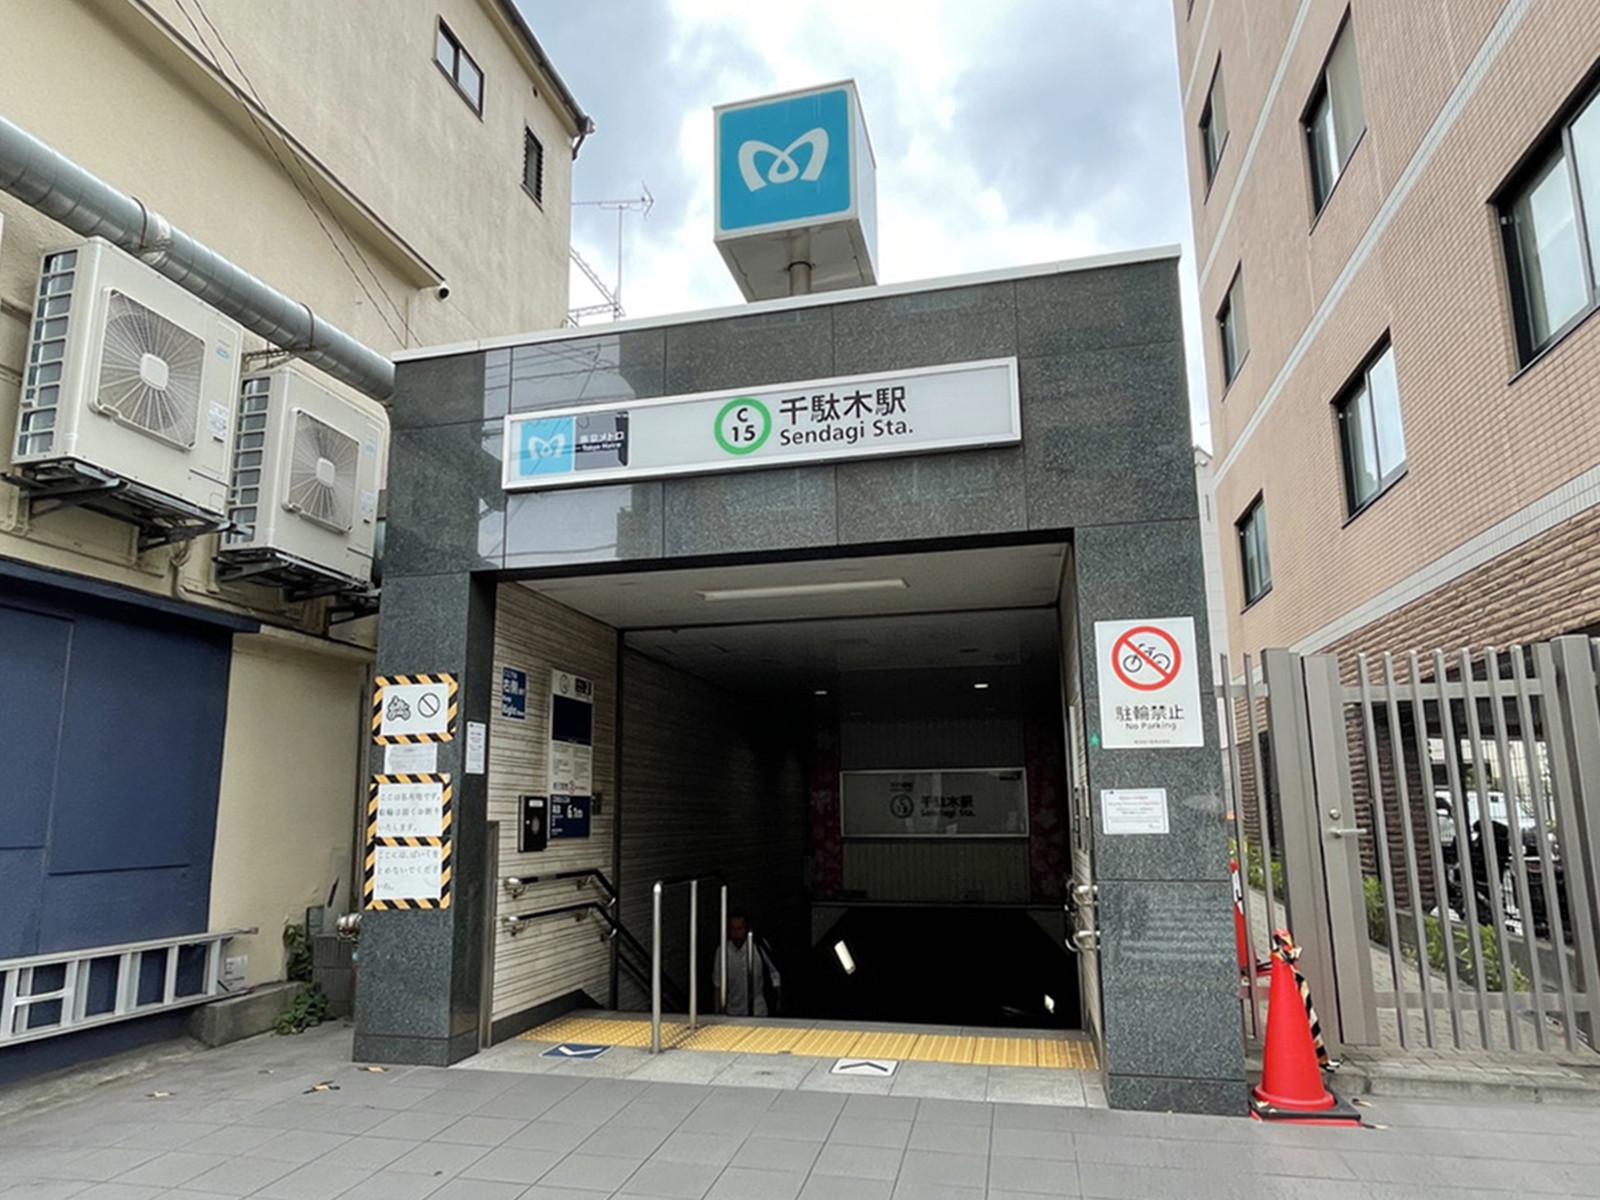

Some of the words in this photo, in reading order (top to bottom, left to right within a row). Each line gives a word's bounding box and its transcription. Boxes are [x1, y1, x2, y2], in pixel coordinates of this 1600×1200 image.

[779, 386, 906, 425] 千駄木駅
[737, 407, 748, 423] C
[732, 424, 756, 442] 15
[780, 421, 865, 446] Sendagi
[873, 419, 913, 437] Sta.
[1115, 704, 1184, 721] 駐輪禁止
[1126, 722, 1139, 730] No
[1141, 720, 1177, 732] Parking
